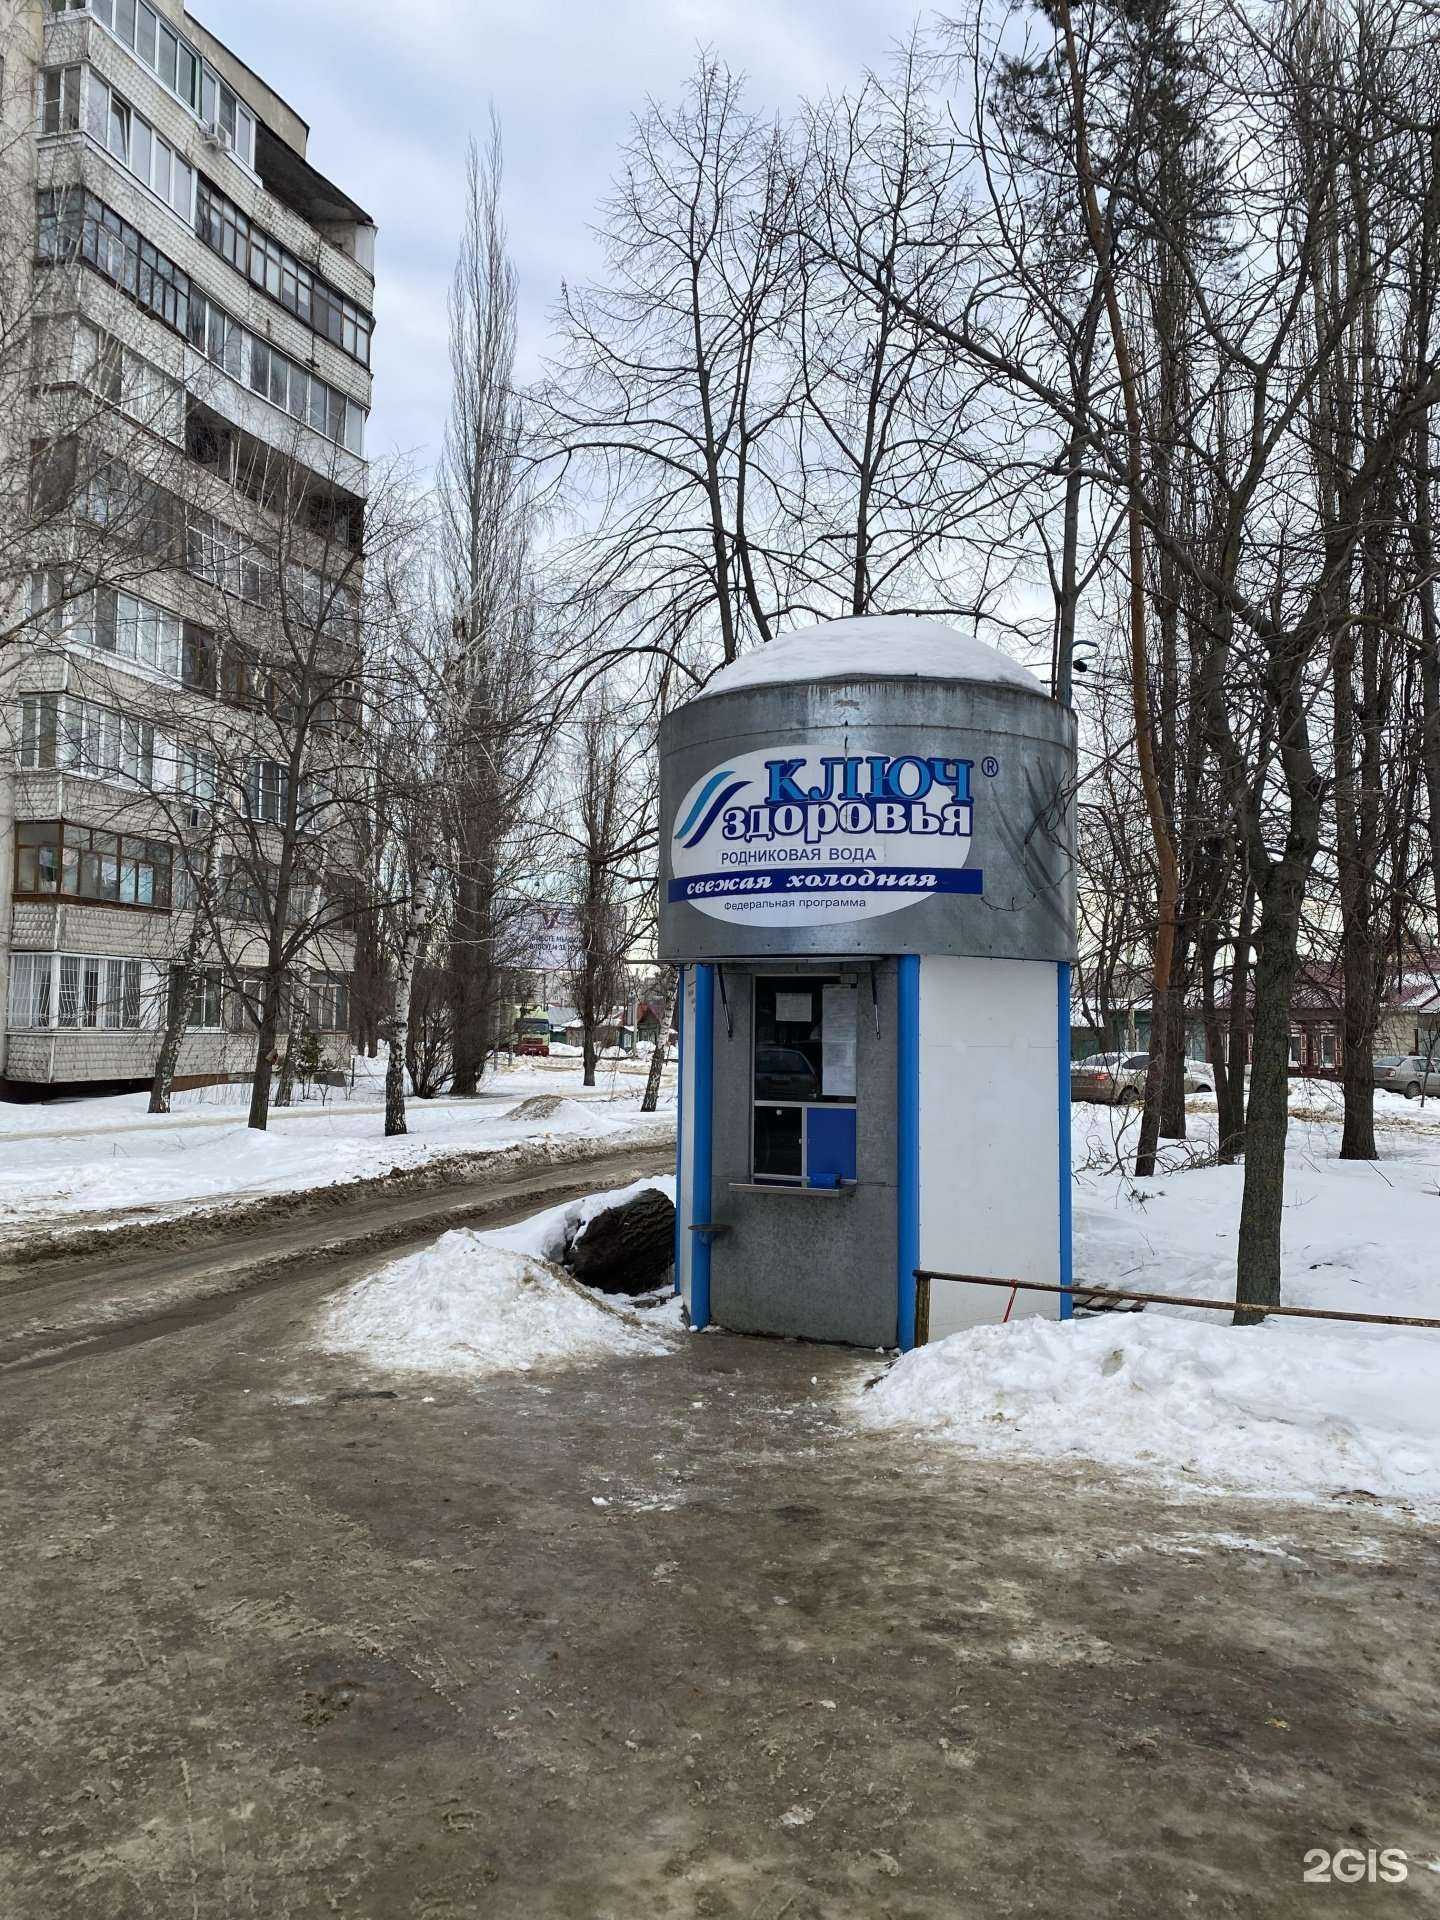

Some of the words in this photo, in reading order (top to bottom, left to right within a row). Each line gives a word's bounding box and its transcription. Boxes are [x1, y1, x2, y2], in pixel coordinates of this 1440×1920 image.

[764, 755, 974, 804] КЛЮЧ
[721, 848, 821, 865] РОДНИКОВАЯ
[828, 847, 877, 862] ВОДА
[686, 874, 773, 895] свежая
[786, 869, 938, 888] холодная
[724, 899, 796, 911] Федеральная
[799, 899, 867, 909] программа
